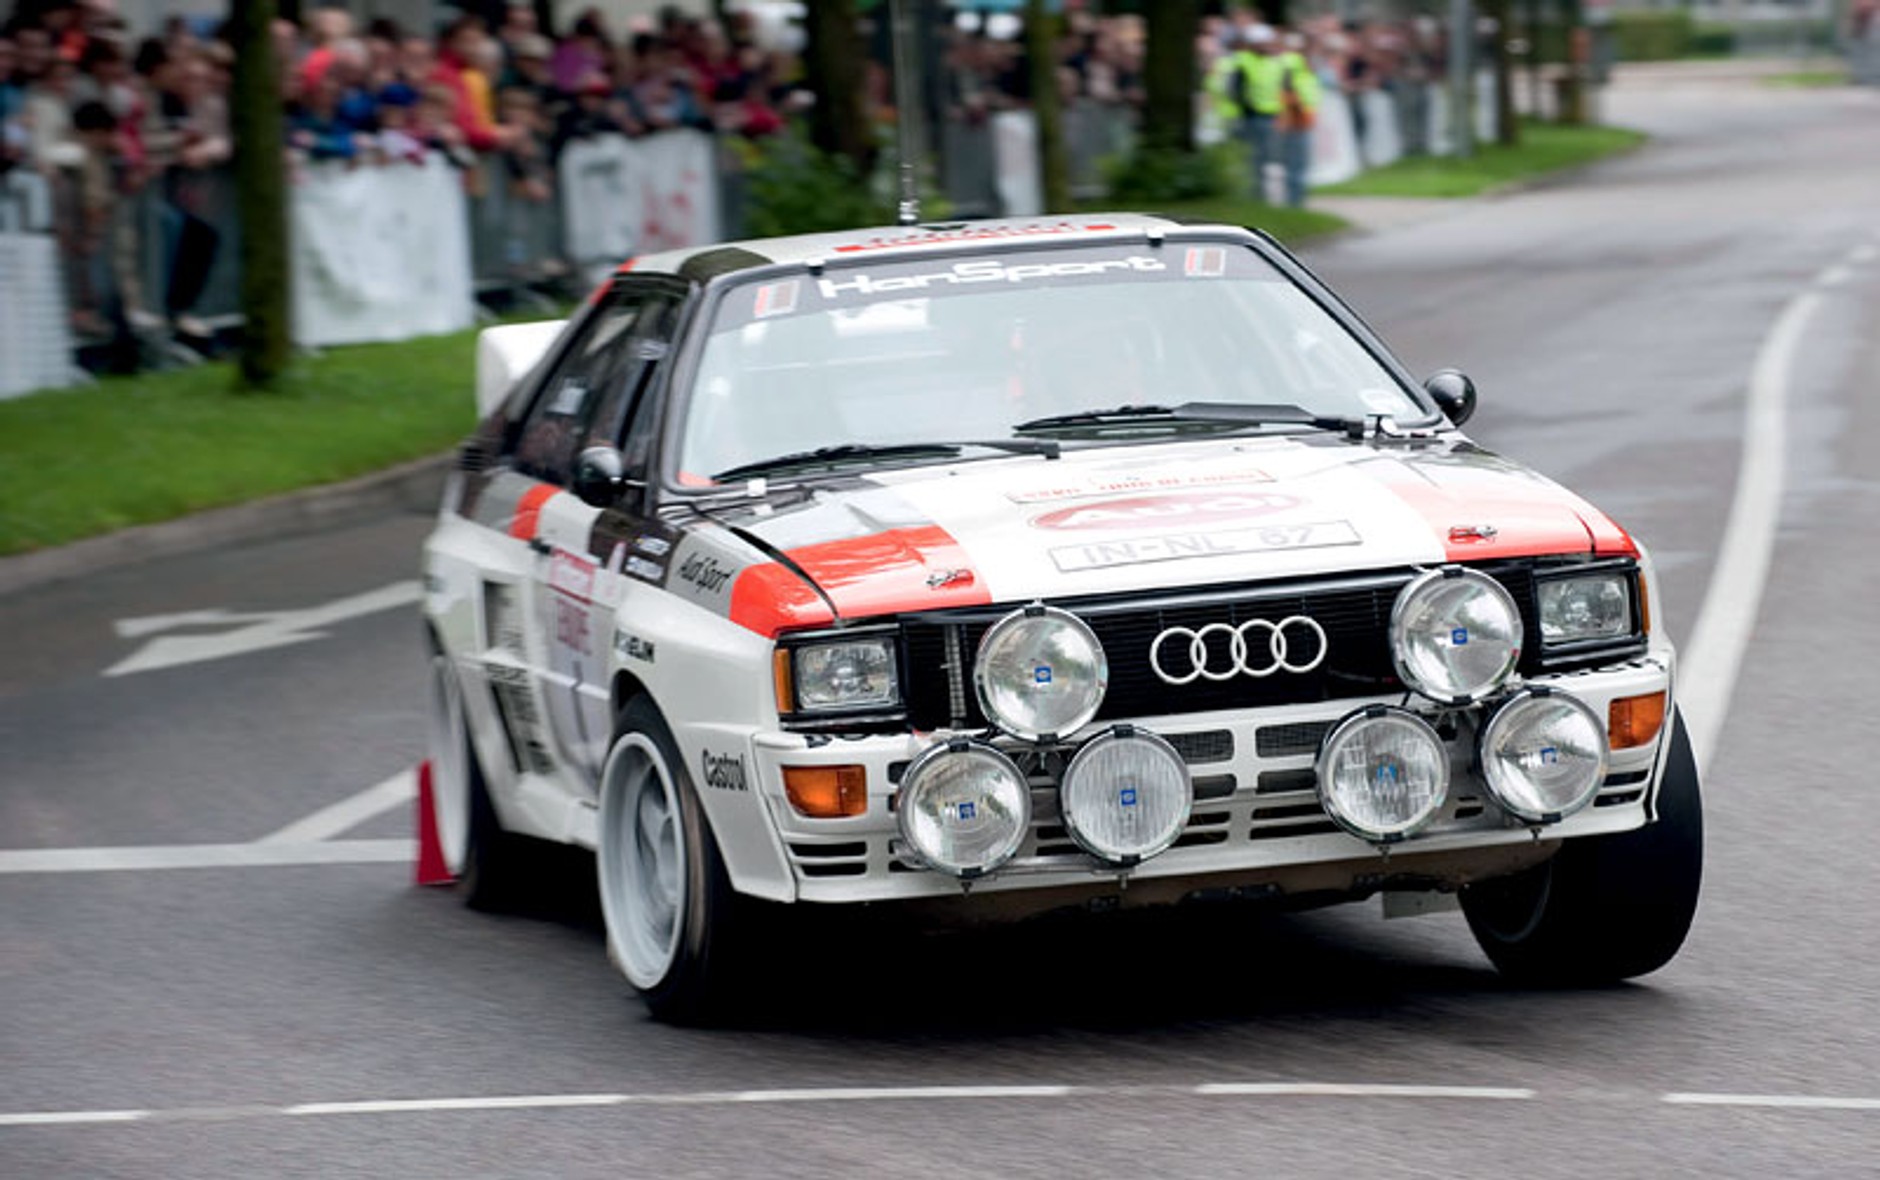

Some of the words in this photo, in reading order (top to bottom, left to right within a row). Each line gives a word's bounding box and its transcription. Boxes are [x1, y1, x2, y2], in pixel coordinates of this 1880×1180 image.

[817, 256, 1166, 298] HanSport
[1083, 532, 1235, 564] IN-NL
[695, 558, 735, 594] Sport
[702, 749, 748, 791] Castrol
